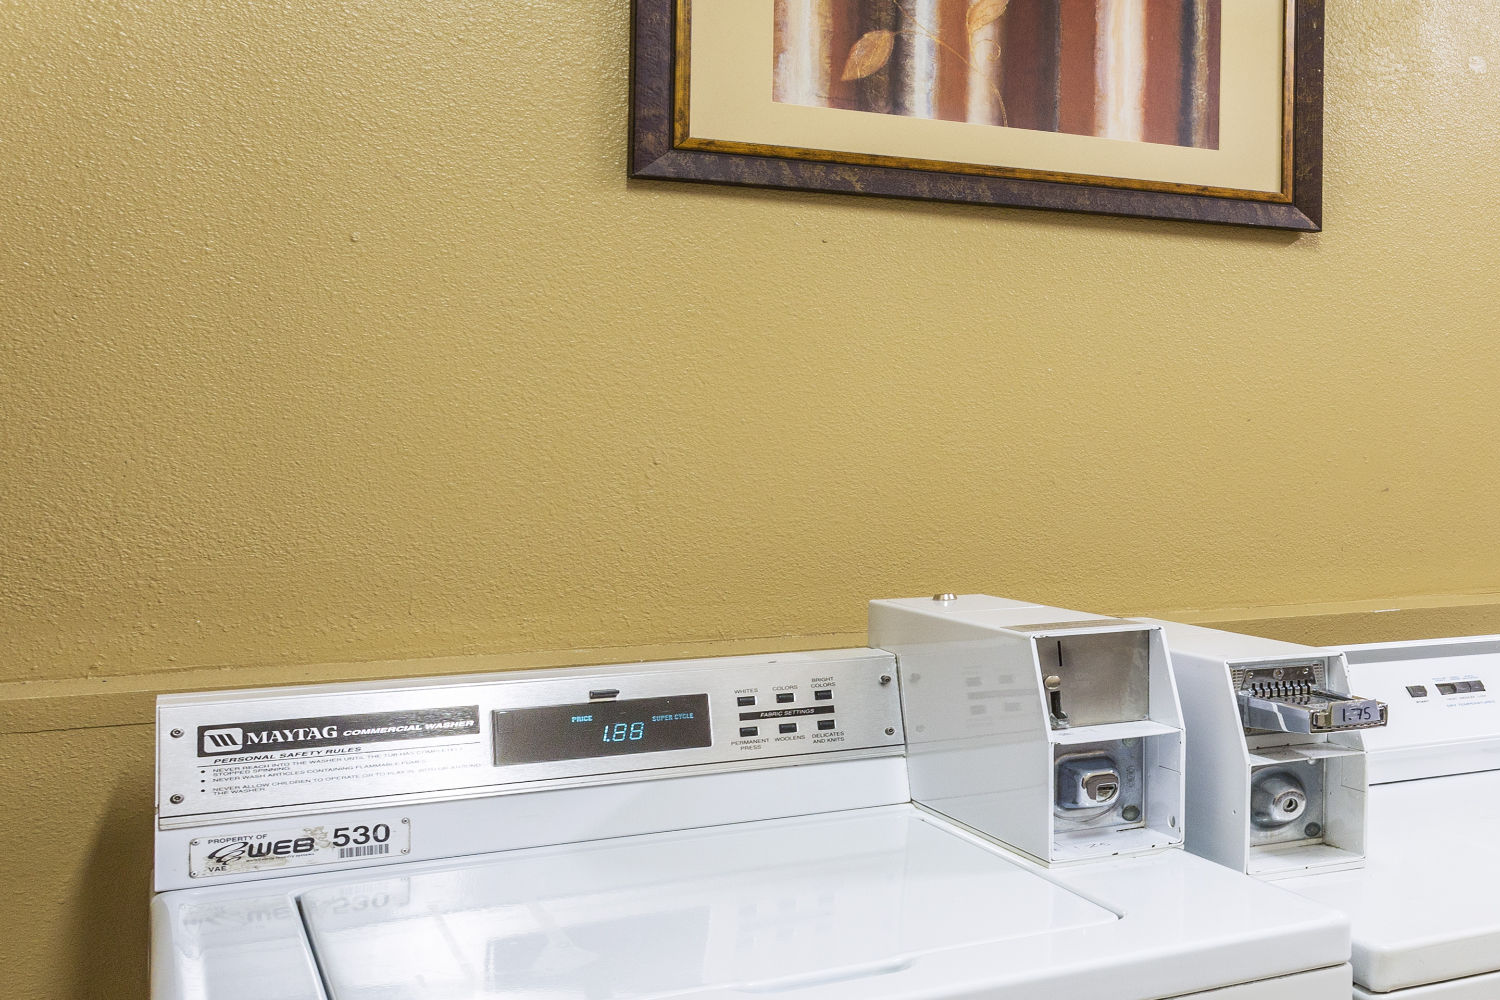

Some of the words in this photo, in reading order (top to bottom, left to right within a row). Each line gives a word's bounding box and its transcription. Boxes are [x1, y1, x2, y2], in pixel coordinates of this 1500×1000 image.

[772, 684, 798, 692] COLORS
[651, 714, 673, 722] SUPER
[674, 712, 694, 720] CYCLE
[784, 708, 815, 716] SETTINGS
[1342, 706, 1372, 722] 1.75
[571, 715, 593, 723] PRICE
[246, 725, 338, 745] MAYTAG
[342, 723, 423, 737] COMMERCIAL
[424, 719, 475, 731] WASHER
[602, 721, 645, 743] 1.88
[811, 731, 845, 739] DELICATES
[731, 738, 770, 746] PERMANENT
[774, 734, 806, 742] WOOLENS
[213, 753, 275, 764] PERSONAL
[279, 750, 323, 759] SAFETY
[325, 746, 362, 754] RULES
[306, 765, 354, 774] CONTAINING
[207, 835, 254, 845] PROPERTY
[332, 823, 391, 847] 530
[247, 837, 315, 858] WEB
